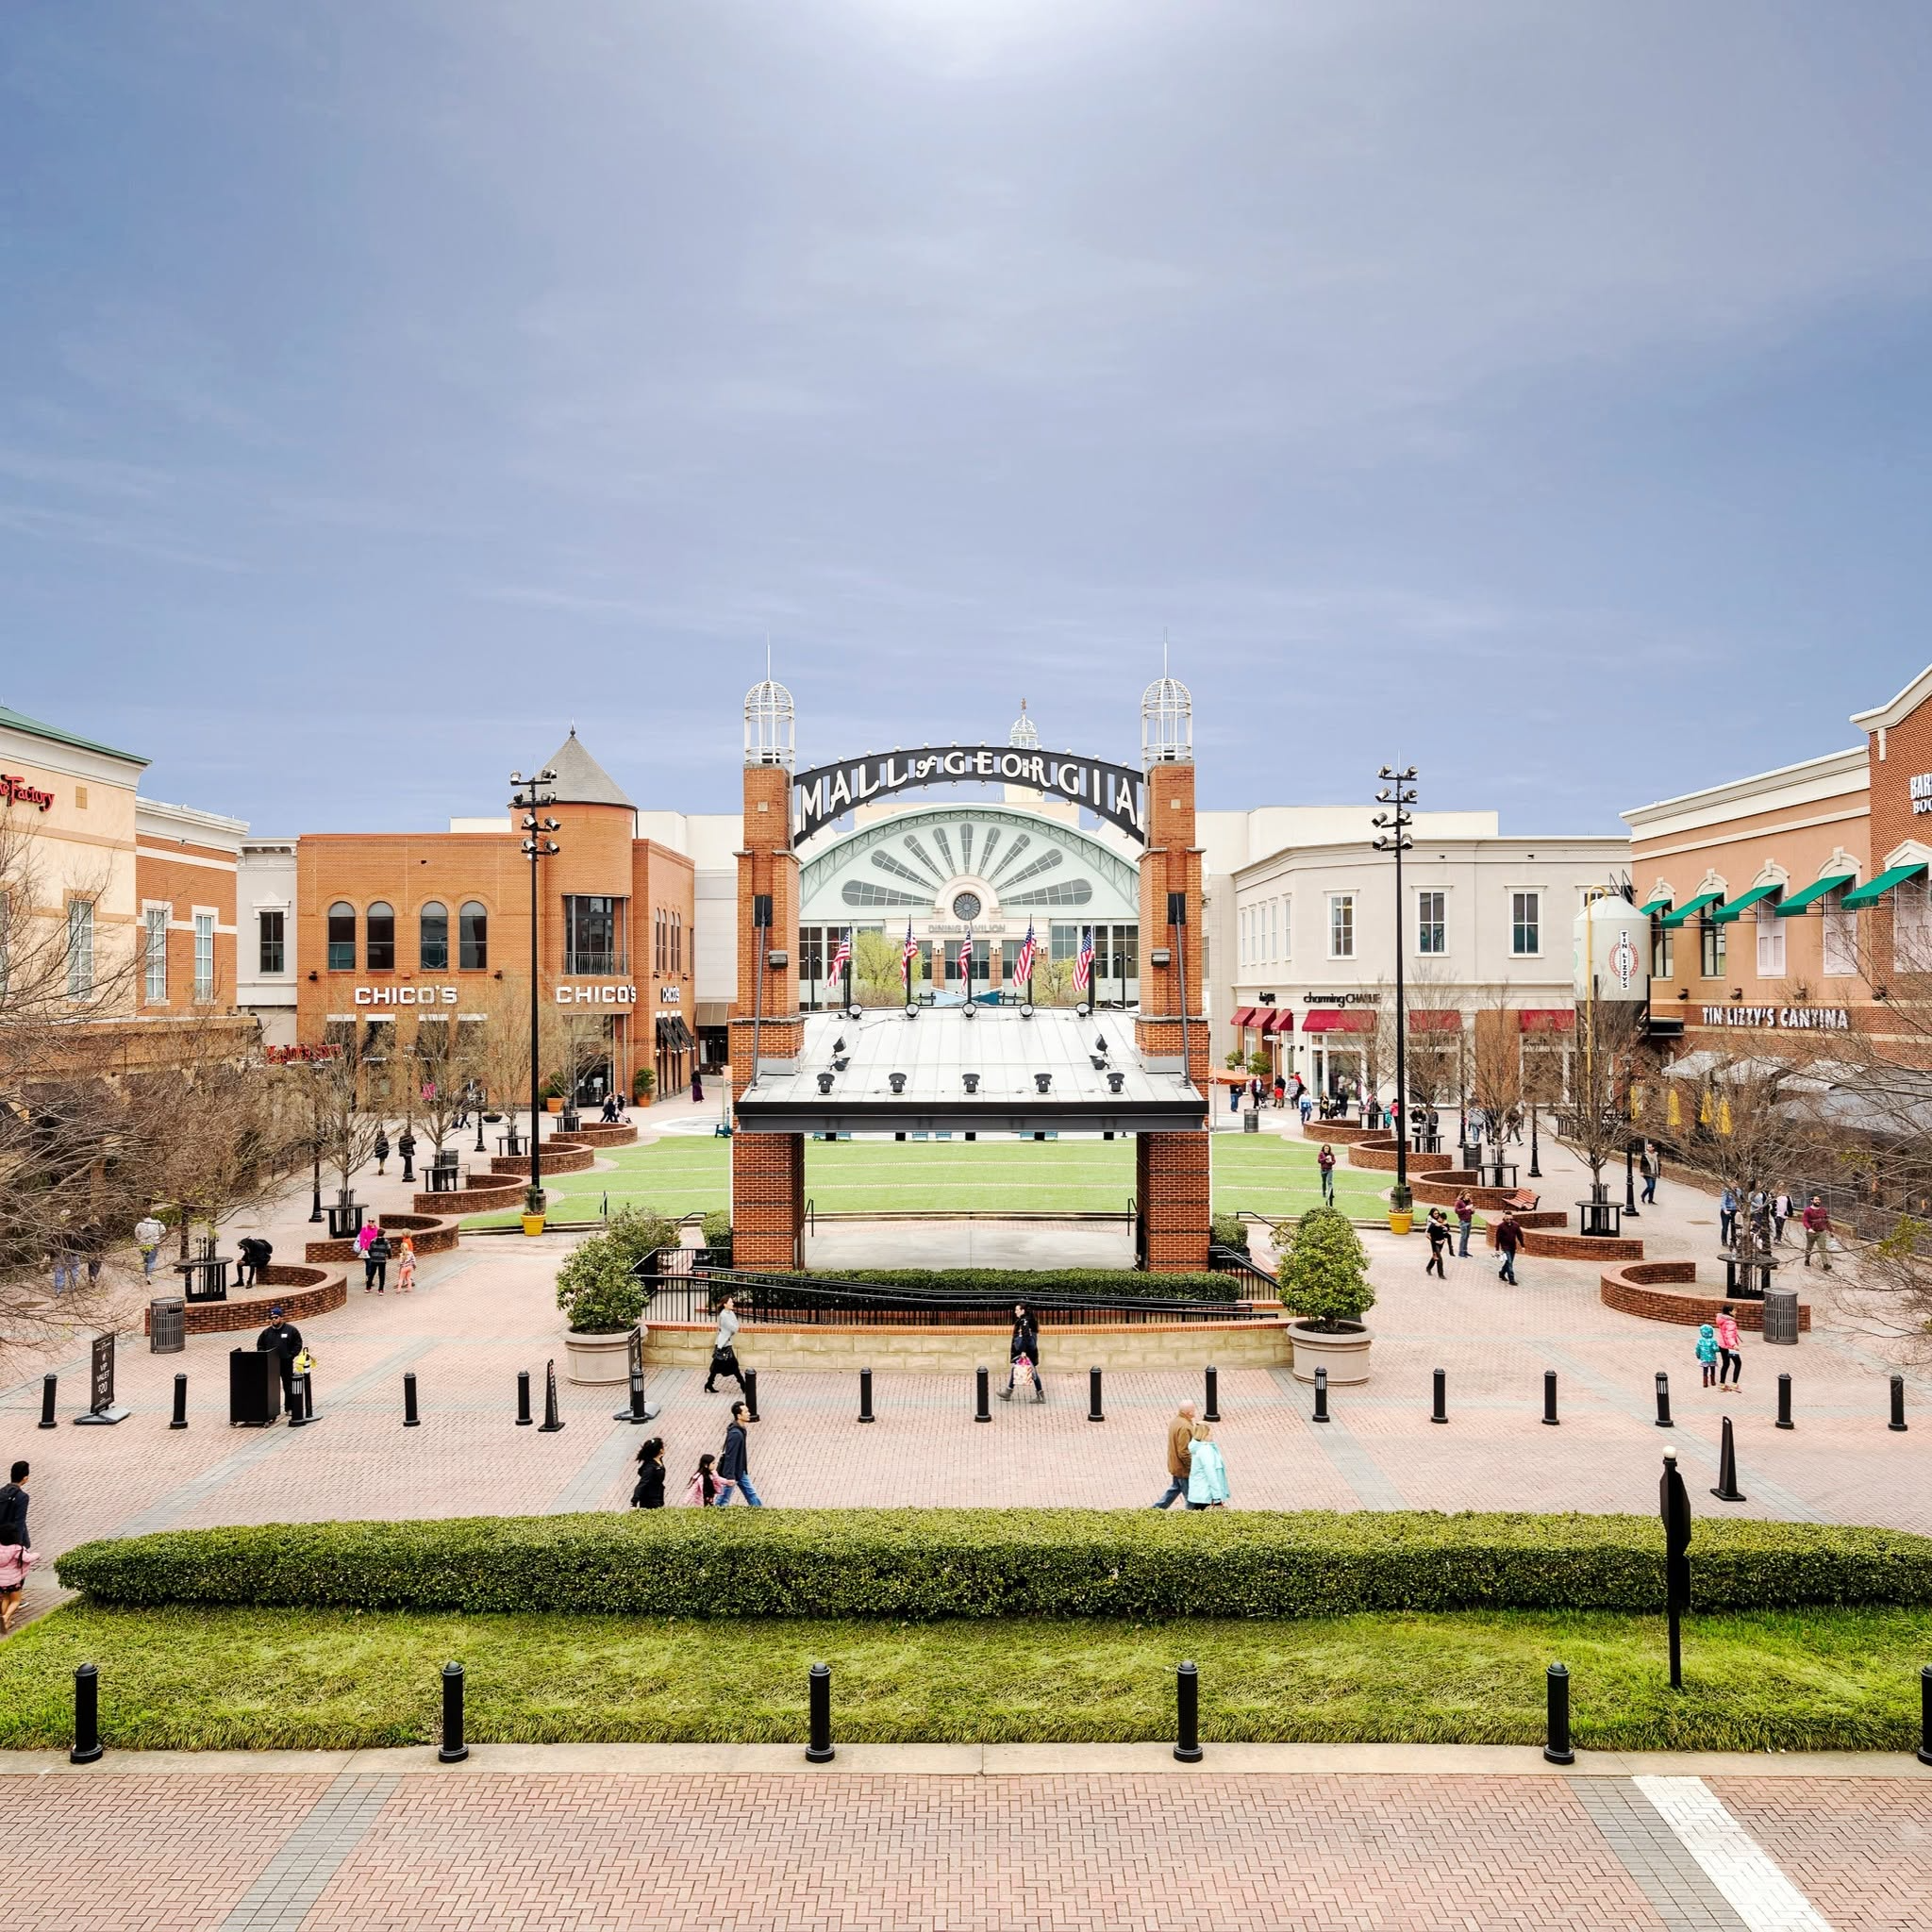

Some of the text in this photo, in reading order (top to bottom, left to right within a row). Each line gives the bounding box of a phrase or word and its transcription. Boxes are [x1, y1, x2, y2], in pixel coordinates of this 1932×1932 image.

[1, 774, 55, 811] Factory
[802, 751, 1137, 831] MALL of GEORGIA
[1910, 774, 1932, 800] BAR
[928, 924, 961, 933] DINING
[355, 985, 458, 1005] CHICO'S
[556, 984, 637, 1003] CHICO'S
[1304, 991, 1345, 1008] charming
[1702, 1007, 1848, 1029] TIN LIZZY'S CANTINA
